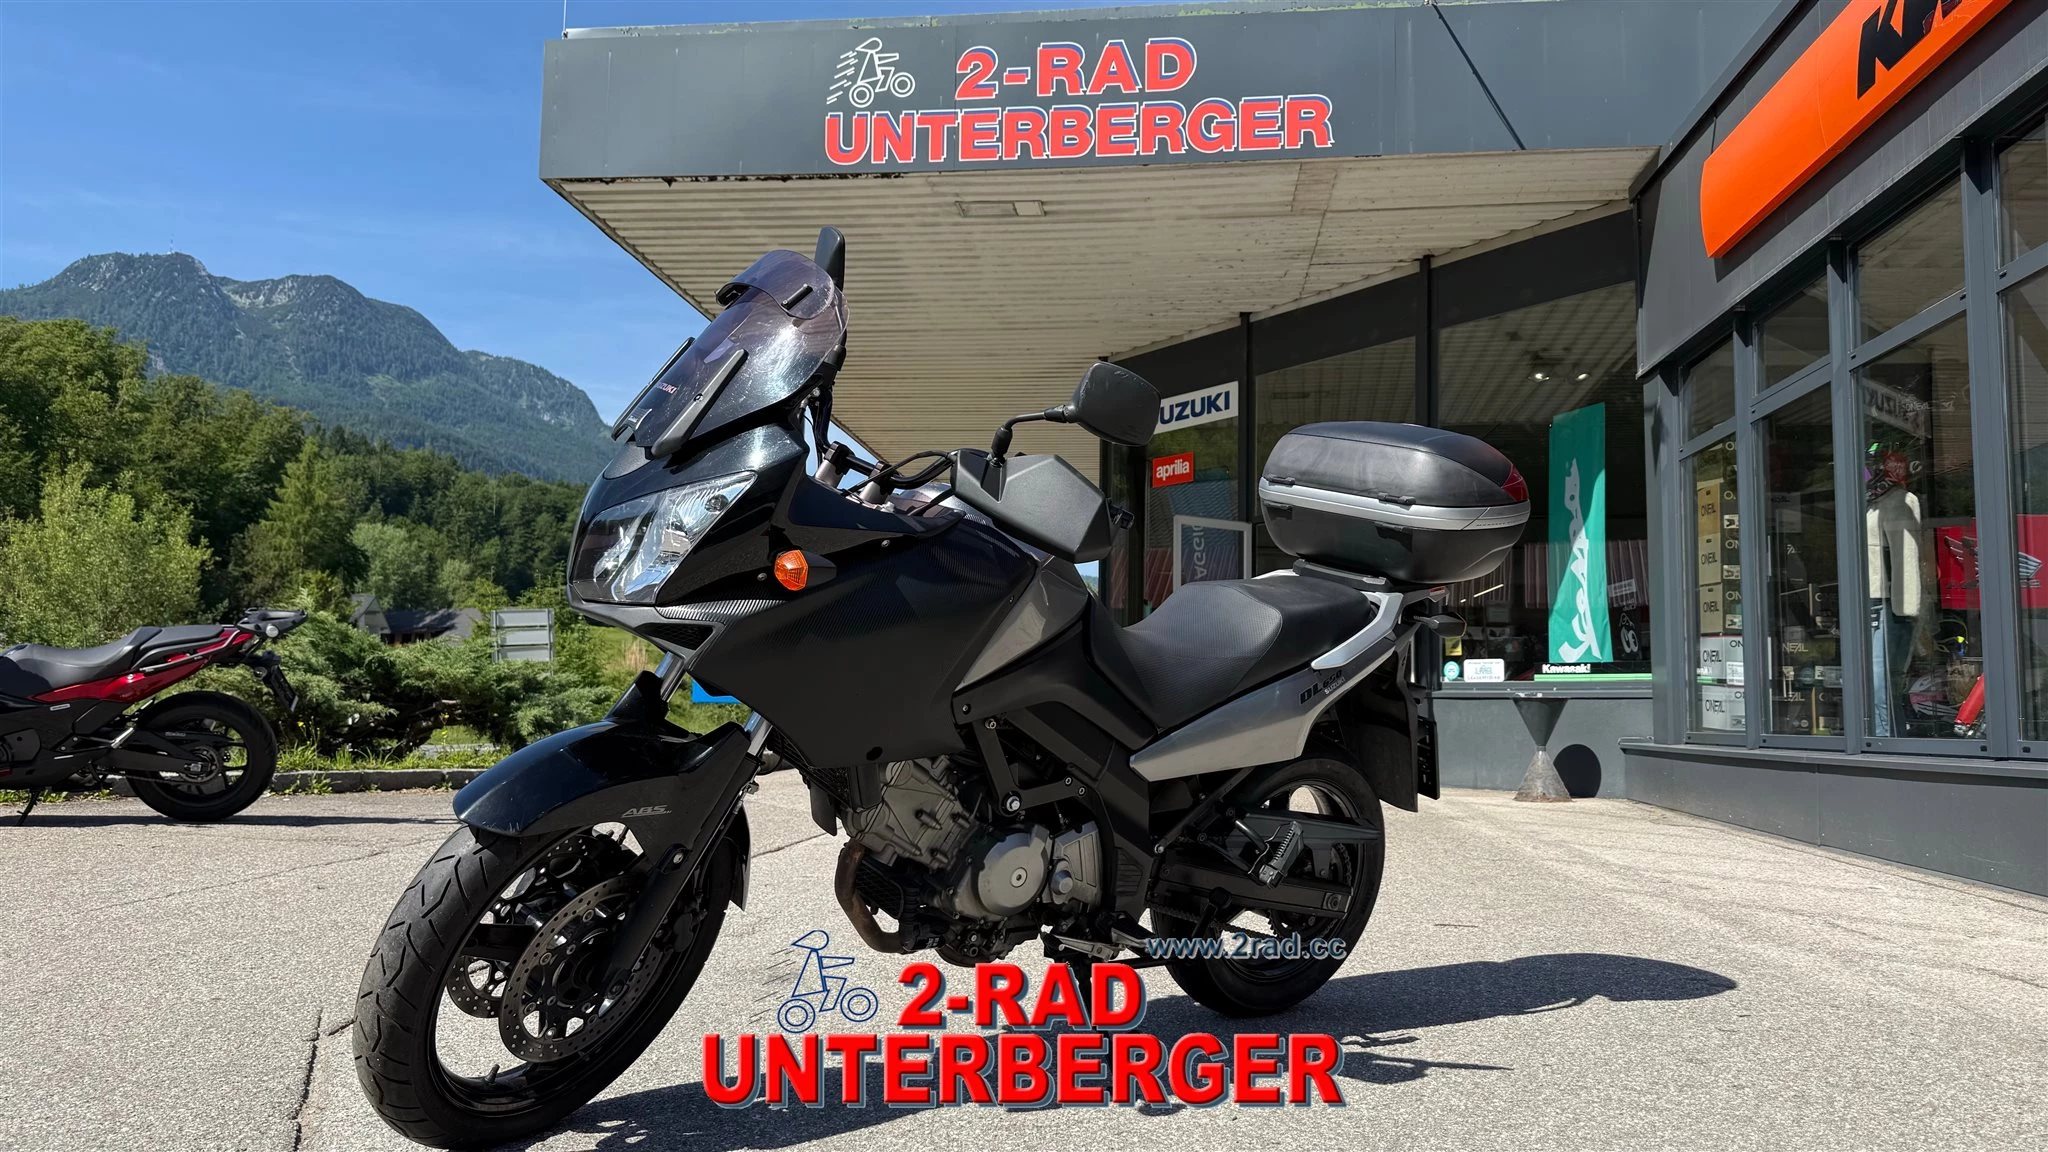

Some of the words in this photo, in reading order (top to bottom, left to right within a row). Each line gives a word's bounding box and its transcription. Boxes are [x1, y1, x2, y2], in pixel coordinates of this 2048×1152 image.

[955, 37, 1197, 100] 2-RAD
[824, 94, 1335, 165] UNTERBERGER
[1159, 390, 1230, 425] UZUKI
[1156, 459, 1190, 481] aprilia
[1542, 664, 1591, 674] Kawasaki
[621, 804, 668, 818] ABS
